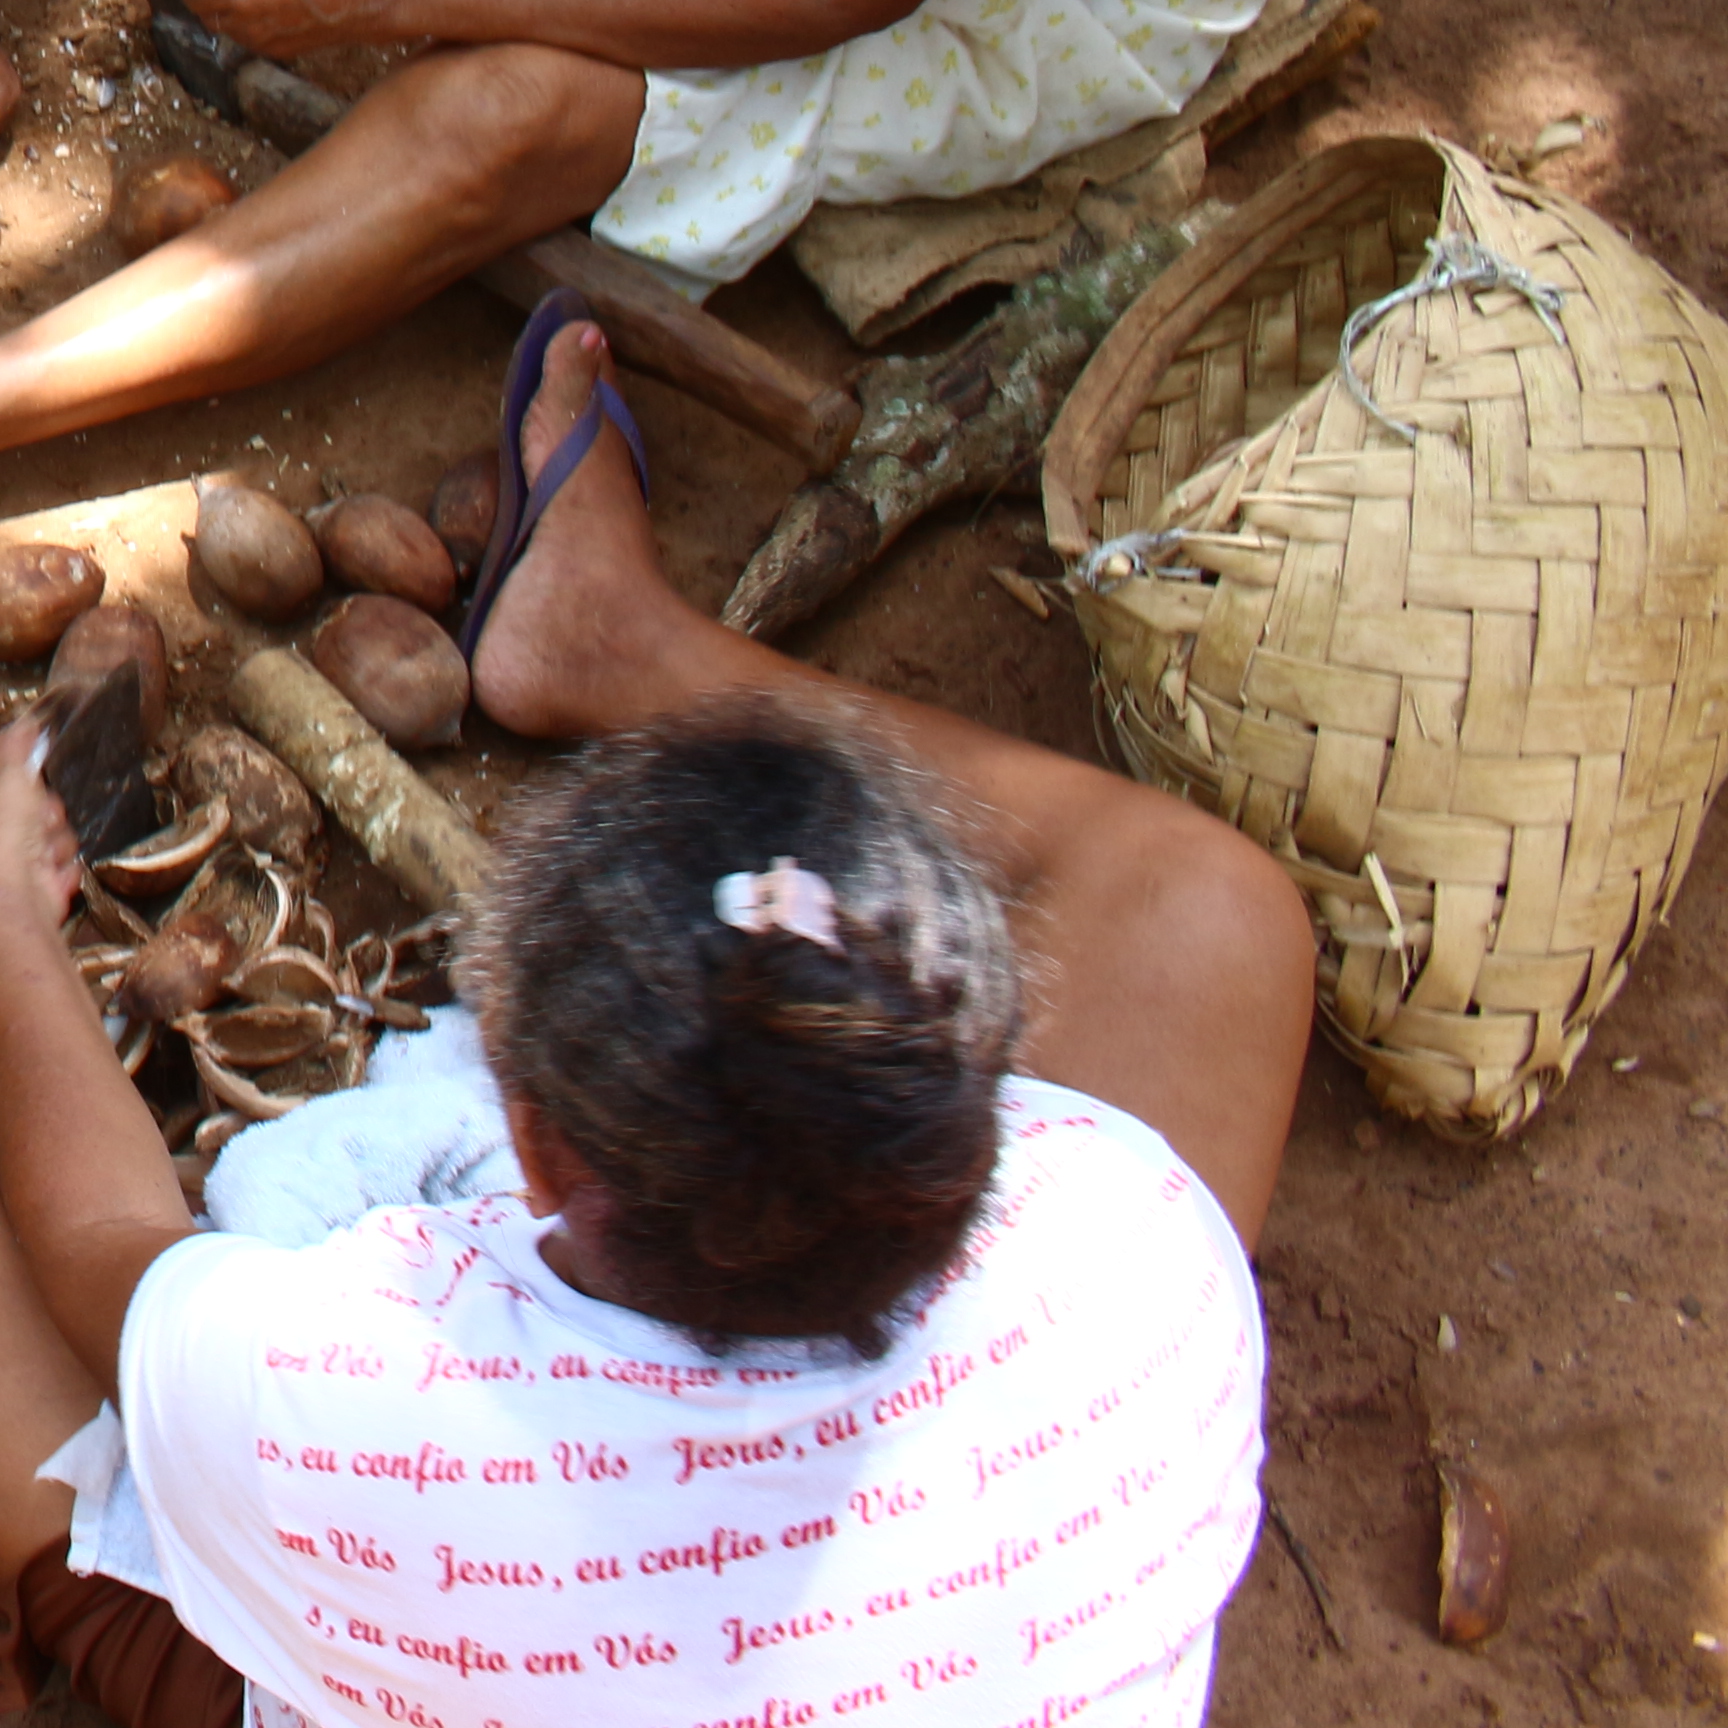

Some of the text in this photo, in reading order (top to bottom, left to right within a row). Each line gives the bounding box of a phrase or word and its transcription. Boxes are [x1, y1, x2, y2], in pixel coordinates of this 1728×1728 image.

[1156, 1162, 1192, 1204] eu
[298, 1445, 342, 1475] eu
[348, 1439, 470, 1496] confio
[479, 1457, 540, 1486] em
[550, 1439, 631, 1484] Vós
[669, 1429, 807, 1486] Jesus,
[813, 1410, 863, 1448] eu
[871, 1352, 977, 1427] confio
[986, 1324, 1029, 1366] em
[415, 1341, 537, 1394] Jesus,
[548, 1353, 594, 1380] eu
[324, 1526, 398, 1574] Vós
[431, 1542, 565, 1596] Jesus,
[572, 1555, 627, 1585] eu
[635, 1524, 770, 1577] confio
[777, 1513, 840, 1550] em
[847, 1480, 927, 1527] Vós
[969, 1422, 1080, 1500] Jesus,
[1087, 1388, 1121, 1423] eu
[320, 1673, 370, 1709] em
[829, 1681, 891, 1717] em
[898, 1649, 979, 1692] Vós
[1017, 1591, 1127, 1667] Jesus,
[346, 1615, 389, 1648] eu
[394, 1632, 513, 1680] confio
[521, 1650, 585, 1677] em
[592, 1631, 679, 1671] Vós
[718, 1607, 855, 1667] Jesus,
[863, 1587, 913, 1618] eu
[925, 1537, 1042, 1595] confio
[1054, 1505, 1102, 1546] em
